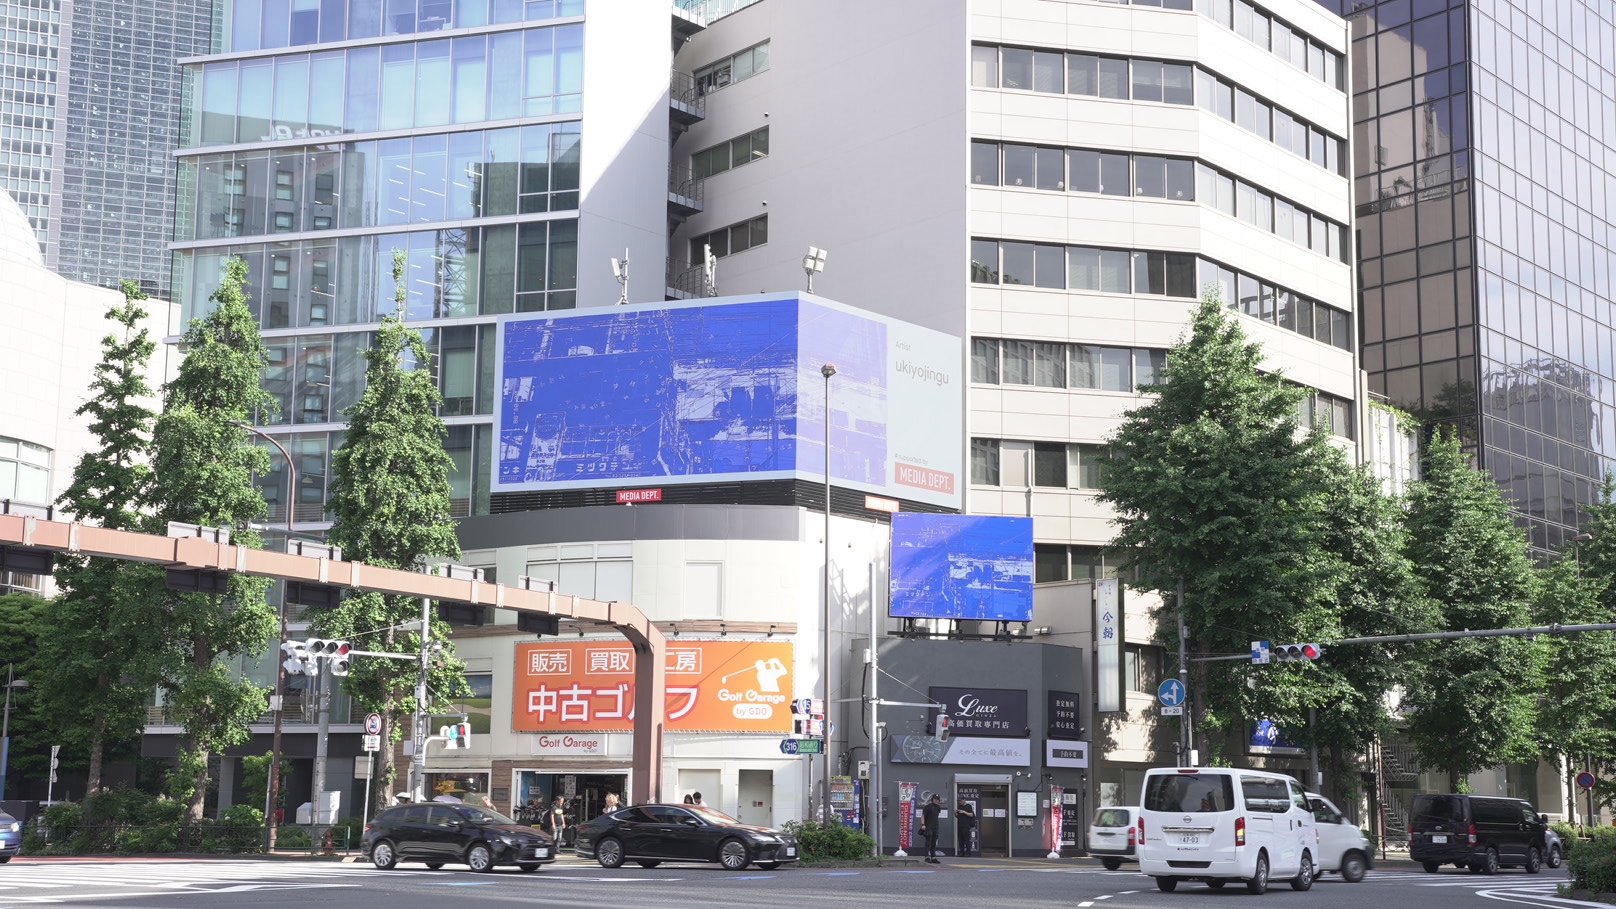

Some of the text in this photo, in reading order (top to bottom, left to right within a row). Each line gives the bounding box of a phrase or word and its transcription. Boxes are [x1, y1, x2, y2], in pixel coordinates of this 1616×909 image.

[895, 341, 911, 352] Artist
[895, 360, 949, 386] ukiyojingu
[900, 466, 951, 491] MEDIA DEPT.
[619, 490, 659, 501] MEDIA DEPT.
[531, 652, 568, 672] 販売
[590, 651, 630, 671] 買取
[528, 684, 697, 722] 中古ゴフ
[717, 688, 786, 704] Golf Garage
[736, 708, 746, 716] by
[955, 694, 998, 717] Luxe
[949, 719, 1010, 729] 高価買取専門店
[1055, 721, 1075, 730] 安心査定
[539, 735, 598, 749] Golf Garage
[785, 742, 797, 751] 316
